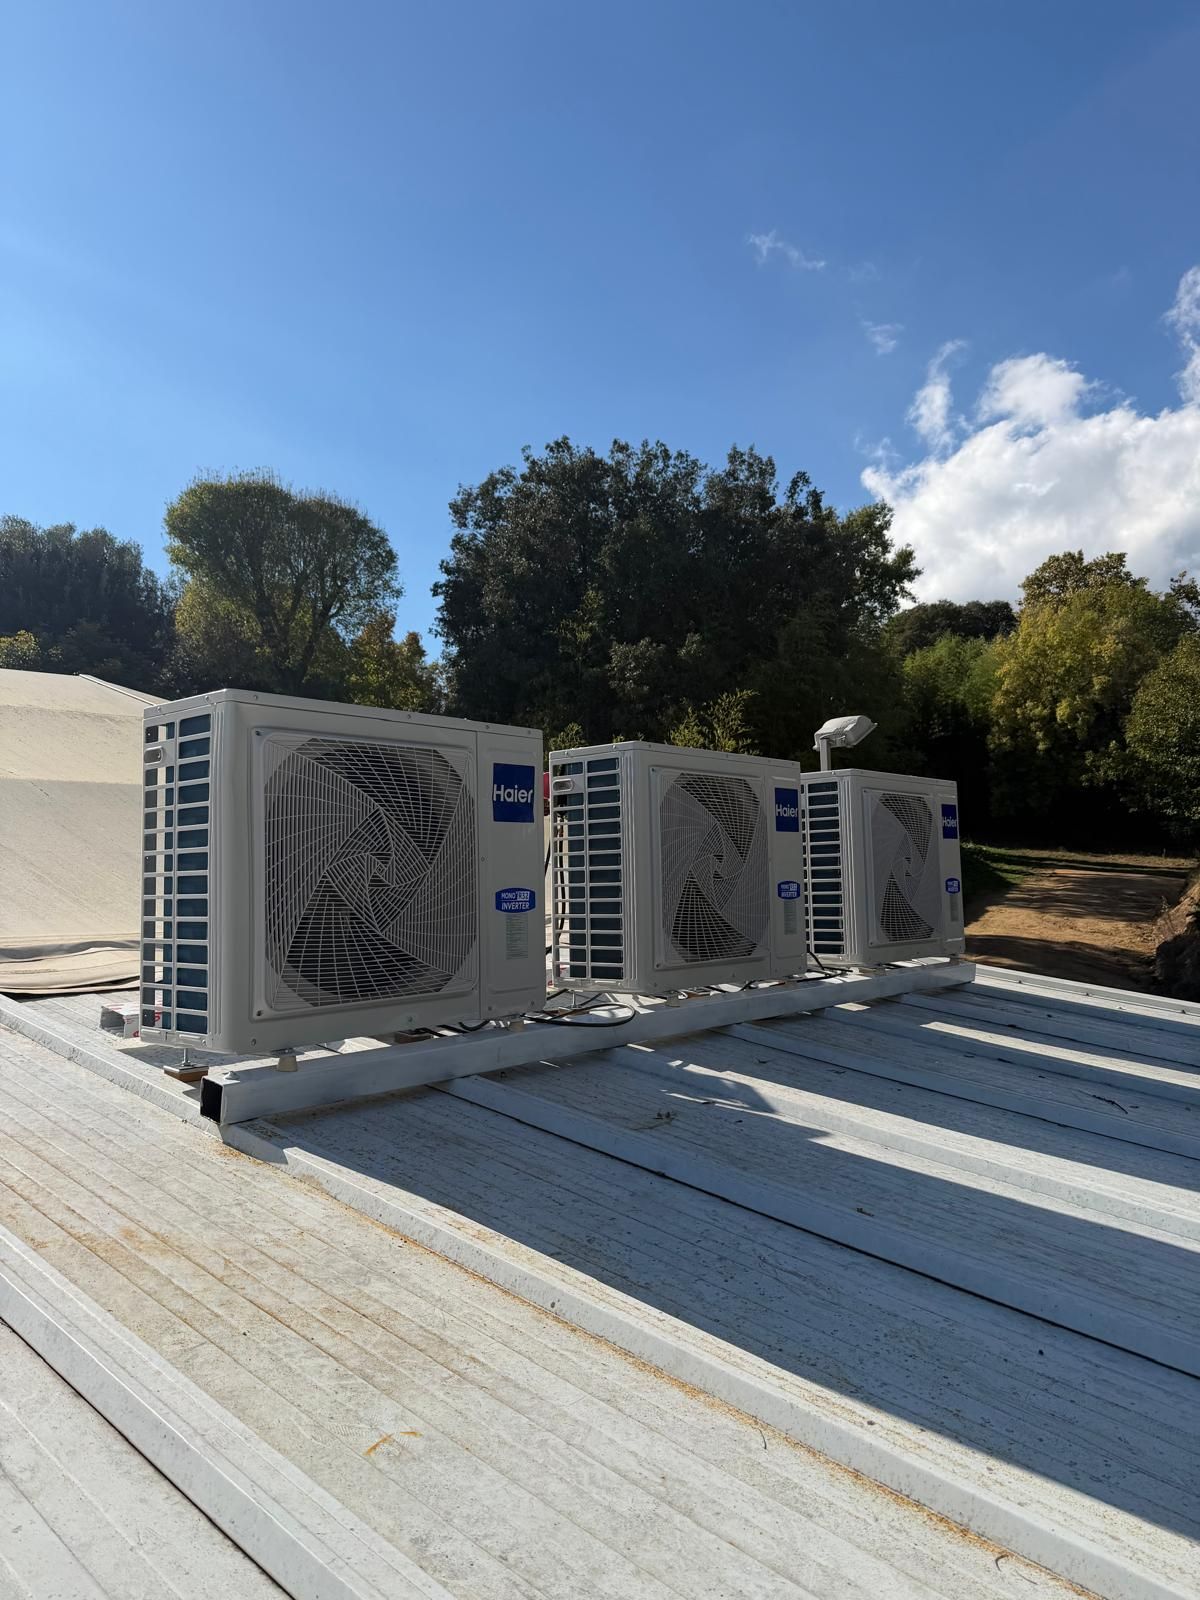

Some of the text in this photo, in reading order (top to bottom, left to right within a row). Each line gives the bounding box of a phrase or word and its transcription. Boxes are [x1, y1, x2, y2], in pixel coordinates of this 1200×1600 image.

[493, 784, 533, 803] Haier
[775, 803, 798, 817] Haier
[942, 816, 957, 828] Haier
[501, 902, 529, 910] INVERTER
